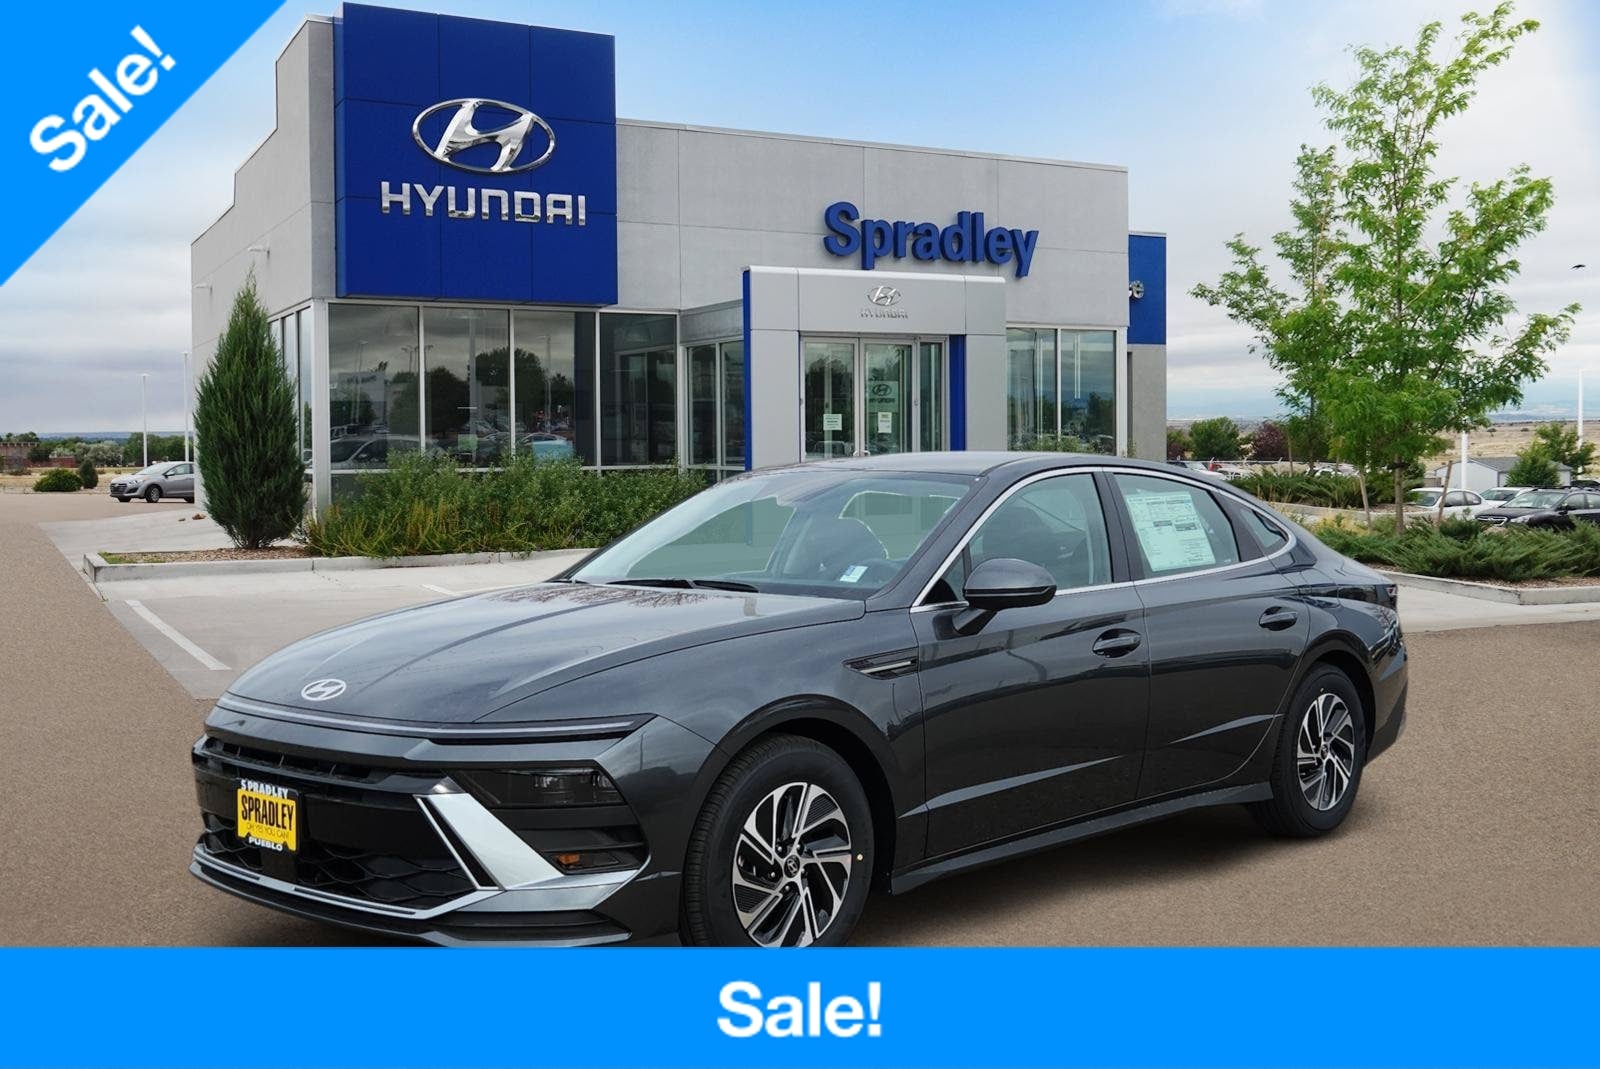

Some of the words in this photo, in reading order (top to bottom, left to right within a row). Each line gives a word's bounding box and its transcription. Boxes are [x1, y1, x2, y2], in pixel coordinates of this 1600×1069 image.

[379, 181, 586, 226] HYUNDAI
[823, 202, 1038, 277] Spradley
[240, 779, 289, 799] SPRADLEY
[241, 794, 294, 831] SPRADLEY
[248, 836, 283, 852] PUEBLO
